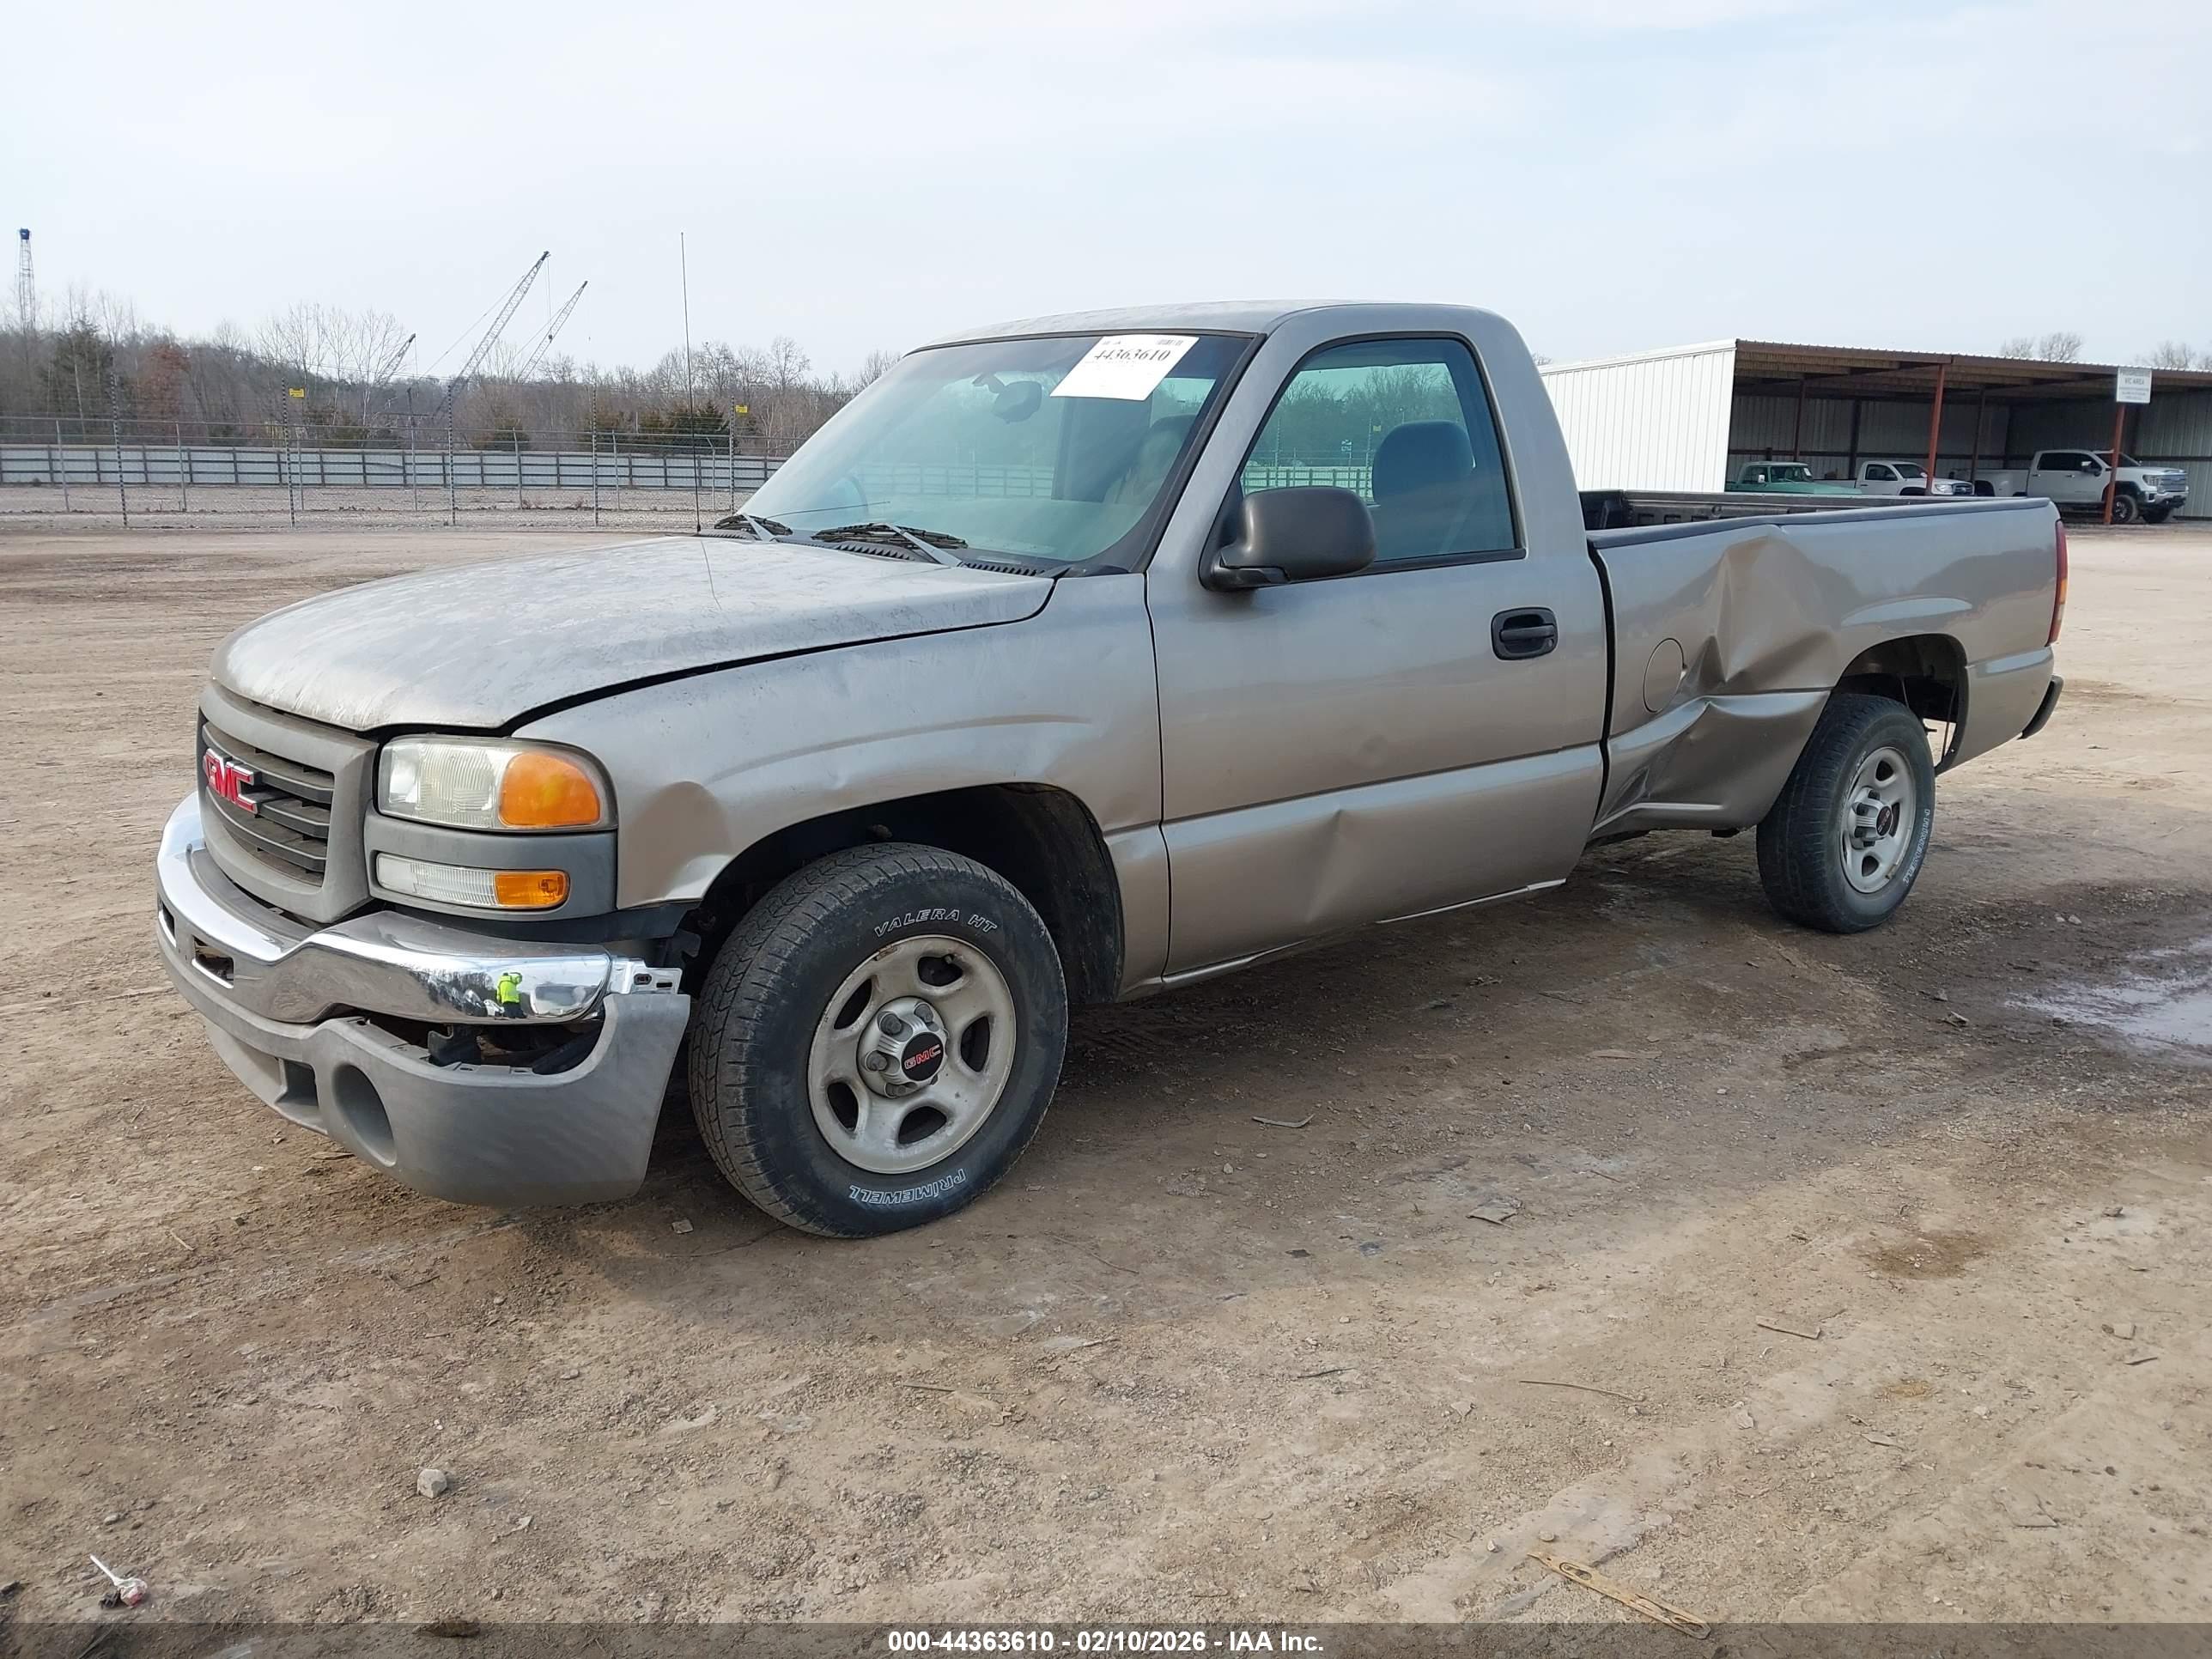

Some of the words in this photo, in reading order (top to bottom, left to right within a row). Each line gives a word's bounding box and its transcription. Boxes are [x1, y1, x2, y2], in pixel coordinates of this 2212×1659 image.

[1094, 349, 1171, 361] 44363610
[203, 748, 258, 815] GMC
[874, 908, 960, 938] VALERA
[967, 914, 998, 933] HT
[904, 1044, 942, 1070] GMC
[848, 1169, 967, 1205] PRIMEWELL
